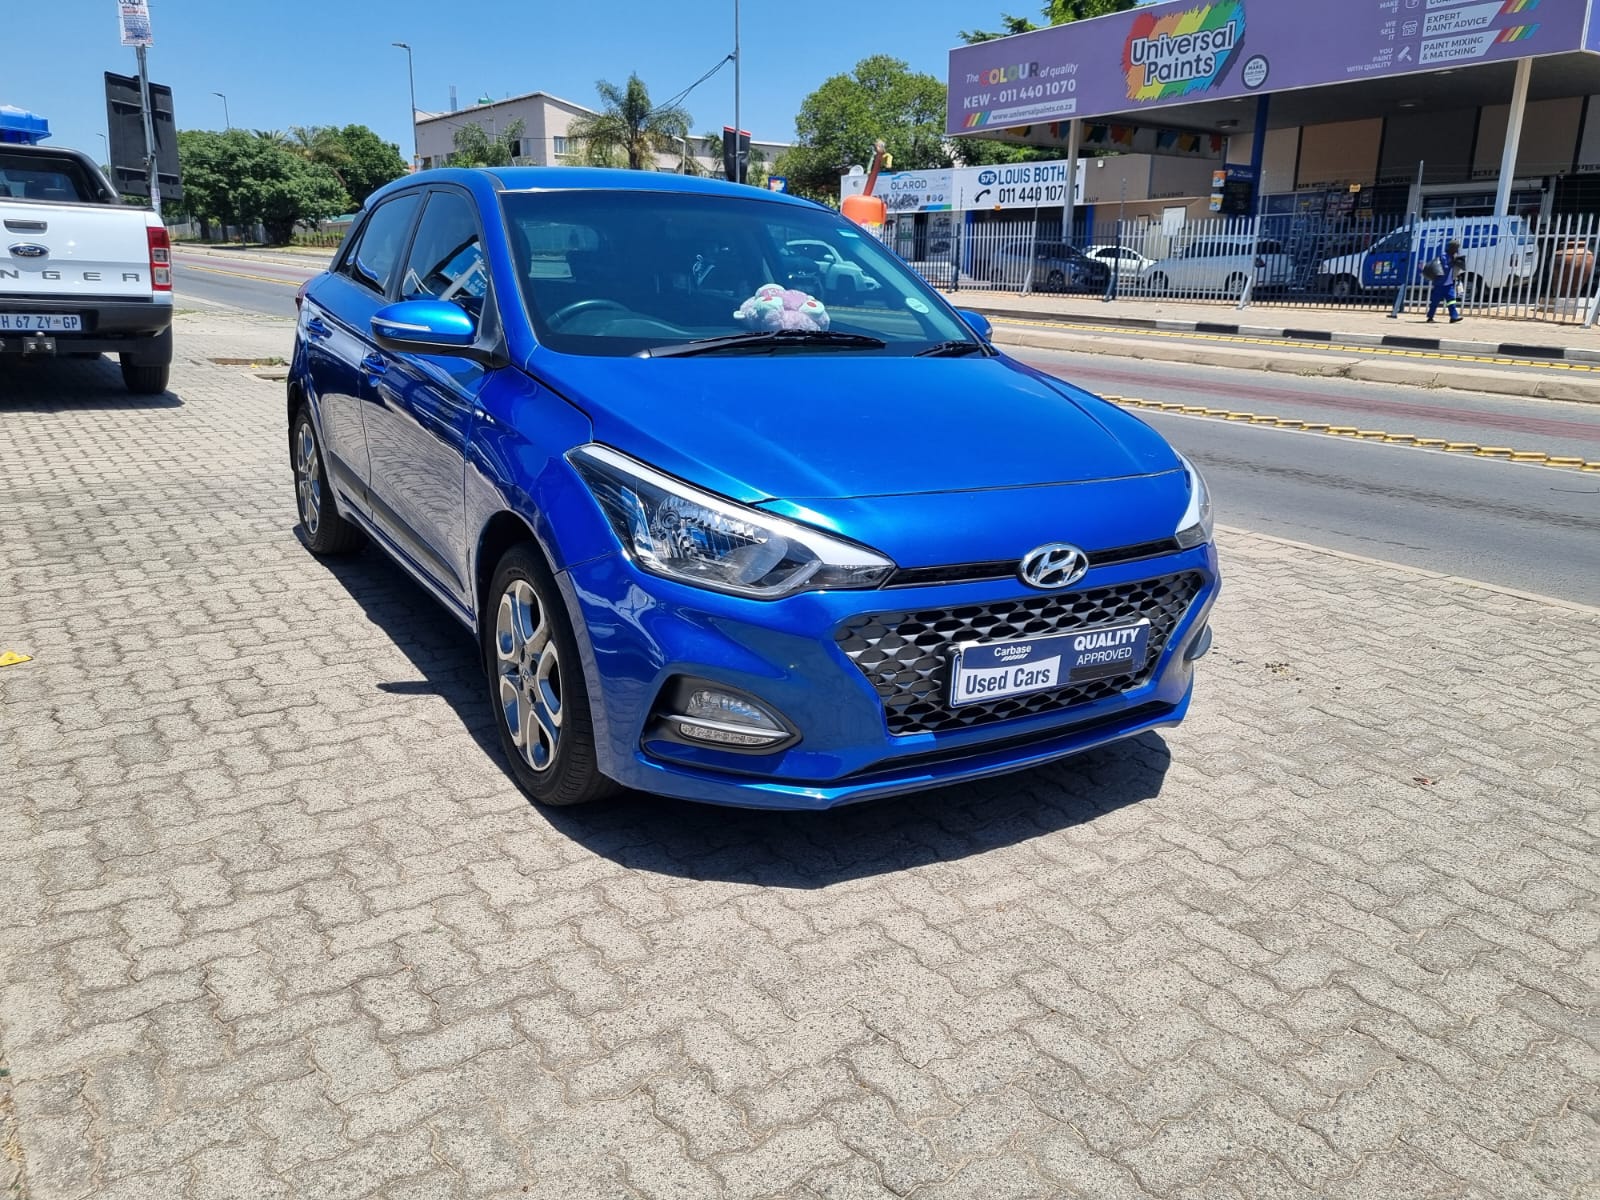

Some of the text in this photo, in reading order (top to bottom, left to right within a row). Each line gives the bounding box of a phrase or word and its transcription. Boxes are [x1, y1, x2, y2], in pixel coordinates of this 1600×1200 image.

[1385, 20, 1396, 28] WE
[1426, 16, 1488, 33] PAINT ADVICE
[1427, 12, 1462, 24] EXPERT
[1380, 27, 1395, 35] SELL
[1131, 22, 1235, 63] Universal
[1423, 36, 1484, 52] PAINT MIXING
[1372, 54, 1393, 63] PAINT
[1429, 46, 1477, 60] MATCHING
[966, 61, 1079, 88] The COLOUR of quality
[1145, 54, 1214, 84] Paints
[1346, 61, 1392, 73] WITH QUALITY
[963, 93, 990, 109] KEW
[999, 88, 1017, 103] 011
[1019, 84, 1043, 100] 440
[1045, 79, 1076, 96] 1070
[992, 104, 1073, 121] www.universalpaints.co.za
[982, 165, 1067, 185] 575 LOUIS BOTH
[998, 187, 1016, 203] 011
[1018, 186, 1042, 202] 440
[17, 246, 42, 257] Ford
[16, 315, 30, 329] 67
[36, 316, 52, 329] ZY
[62, 316, 78, 329] GP
[1073, 627, 1141, 652] QUALITY
[994, 644, 1032, 658] Carbase
[1076, 646, 1132, 666] APPROVED
[965, 666, 1050, 696] Used Cars
